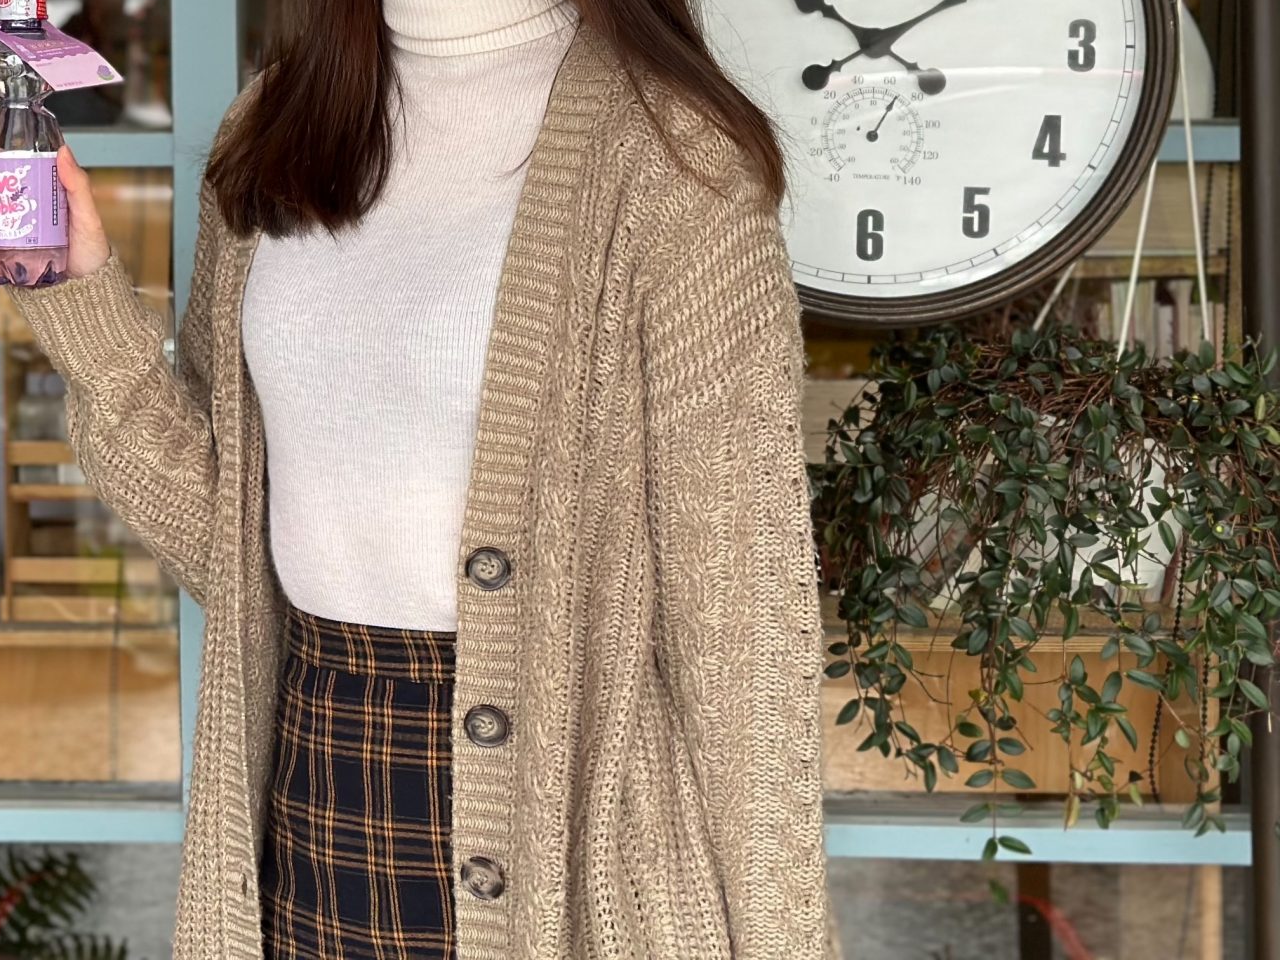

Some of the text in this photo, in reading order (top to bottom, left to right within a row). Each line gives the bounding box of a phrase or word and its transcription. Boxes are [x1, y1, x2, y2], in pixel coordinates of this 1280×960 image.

[1067, 19, 1097, 72] 3
[851, 75, 864, 85] 40
[883, 76, 896, 85] 60
[823, 90, 836, 100] 20
[910, 92, 924, 101] 80
[1032, 114, 1067, 167] 4
[923, 151, 939, 160] 120
[903, 176, 921, 186] 140
[962, 186, 991, 238] 5
[856, 208, 885, 261] 6
